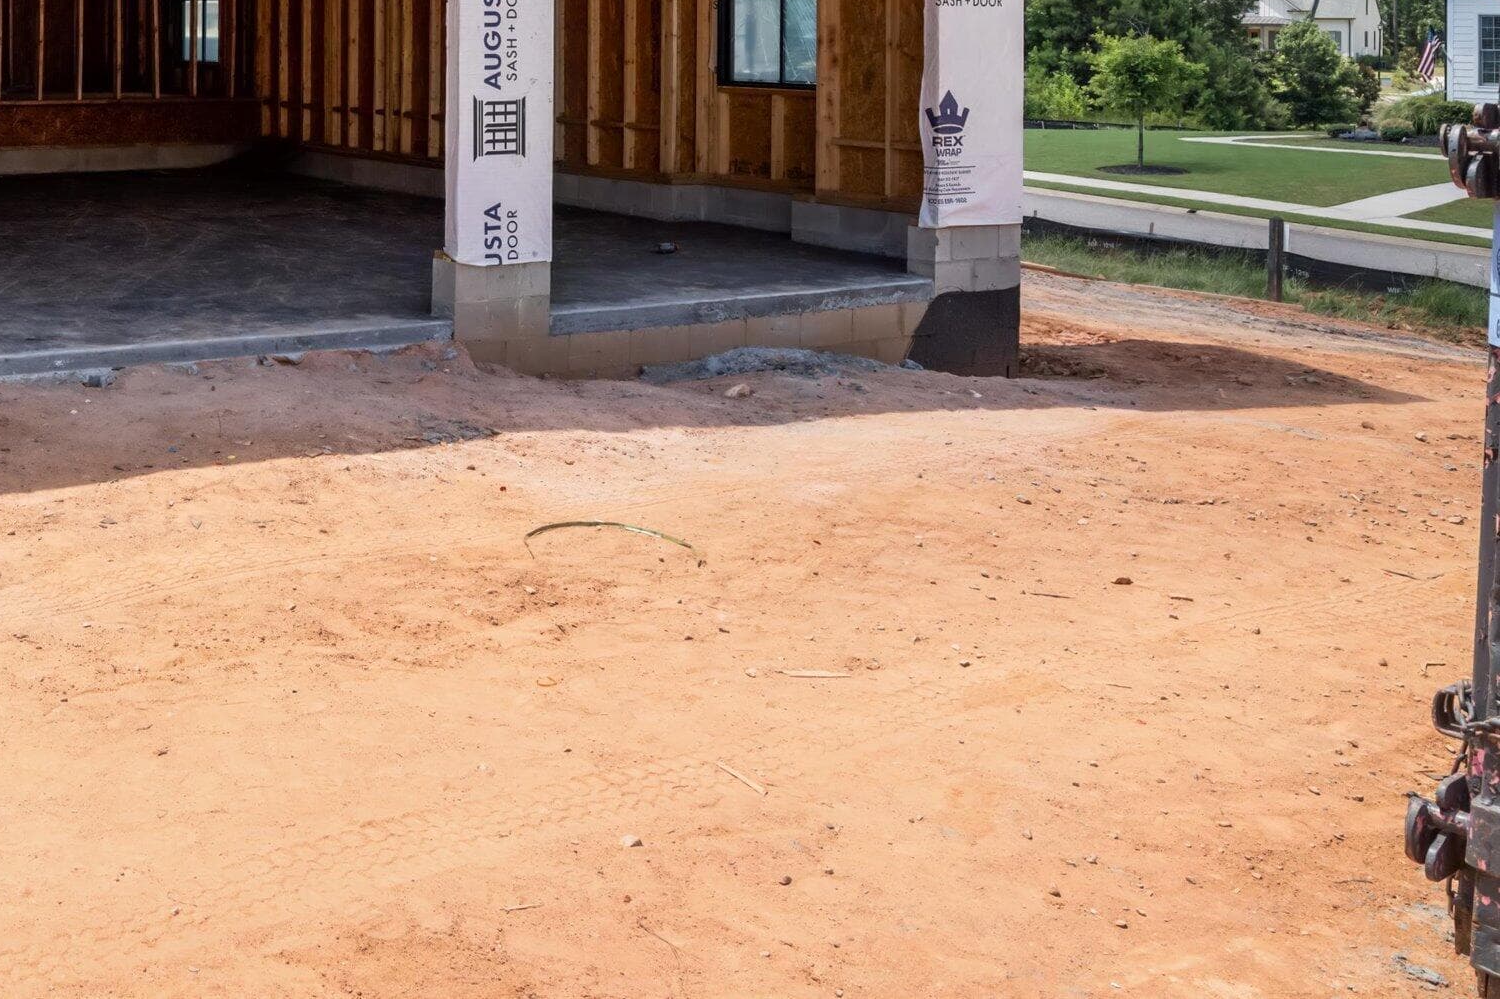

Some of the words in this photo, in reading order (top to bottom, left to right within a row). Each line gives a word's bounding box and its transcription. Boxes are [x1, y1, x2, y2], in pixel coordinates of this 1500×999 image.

[506, 38, 518, 81] SASH
[931, 136, 964, 147] REX
[935, 148, 962, 157] WRAP
[506, 210, 518, 260] DOOR
